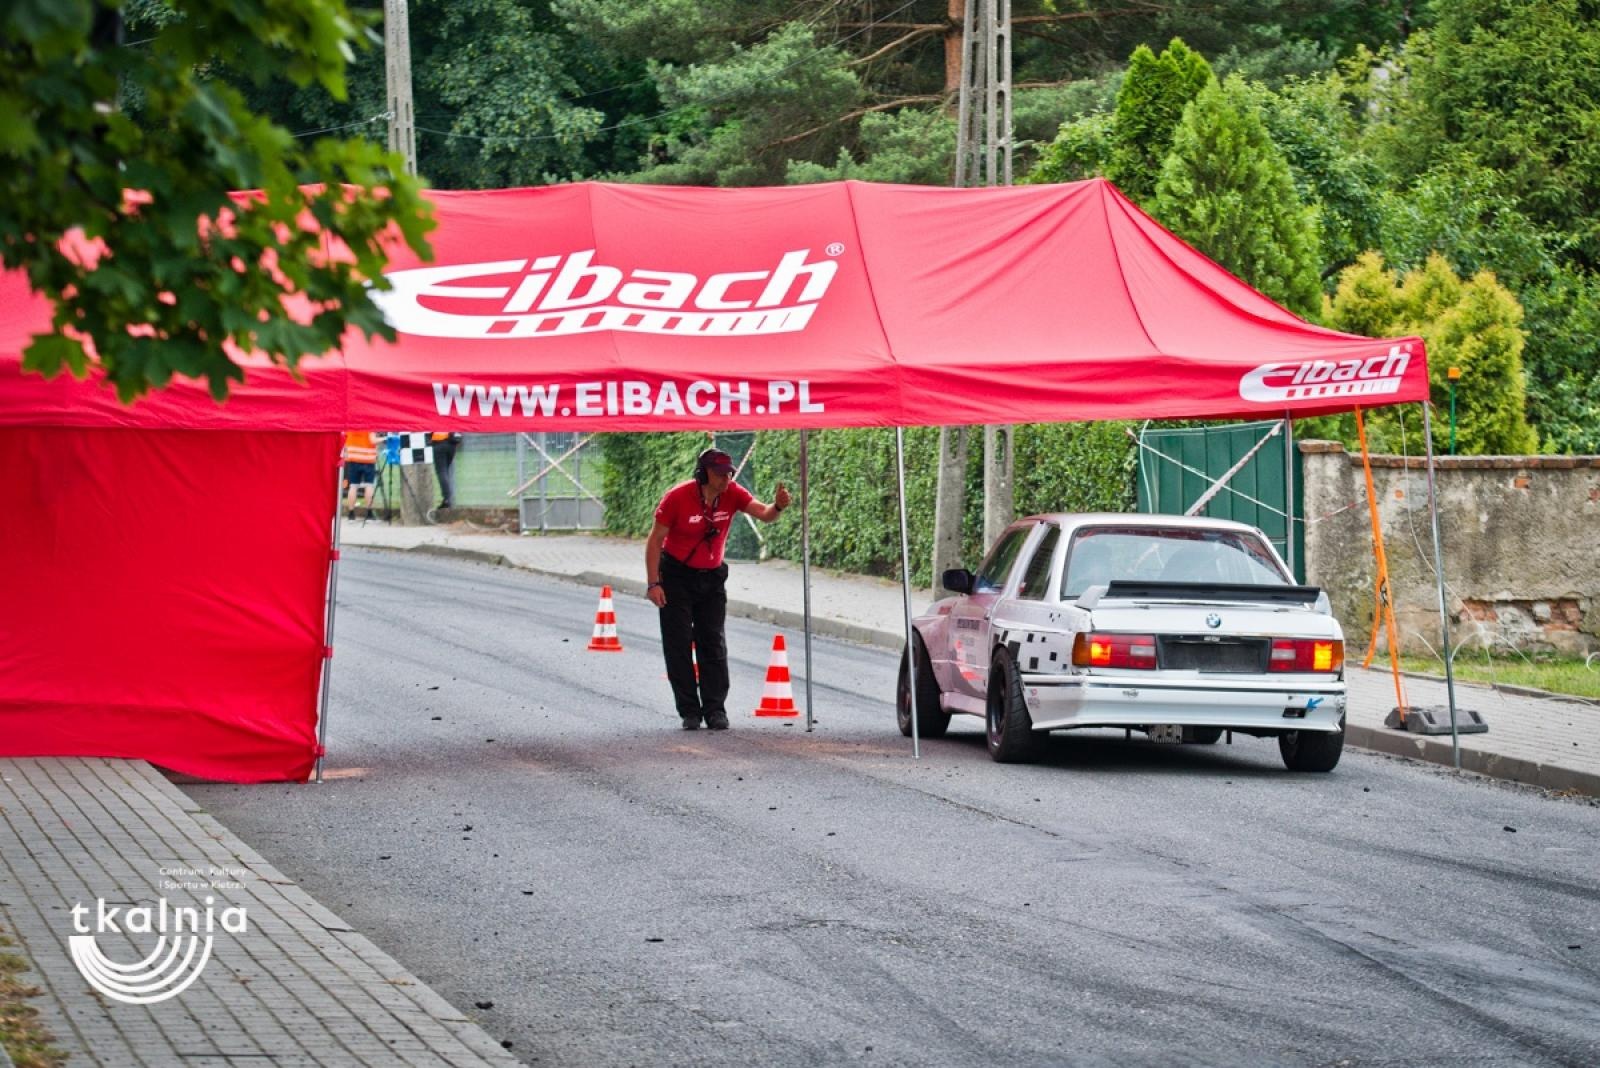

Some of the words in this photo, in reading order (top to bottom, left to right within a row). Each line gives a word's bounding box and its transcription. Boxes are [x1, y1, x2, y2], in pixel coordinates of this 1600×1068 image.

[366, 249, 839, 339] Eibach
[432, 379, 825, 417] WWW.EIBACH.PL
[1239, 346, 1411, 403] Eibach
